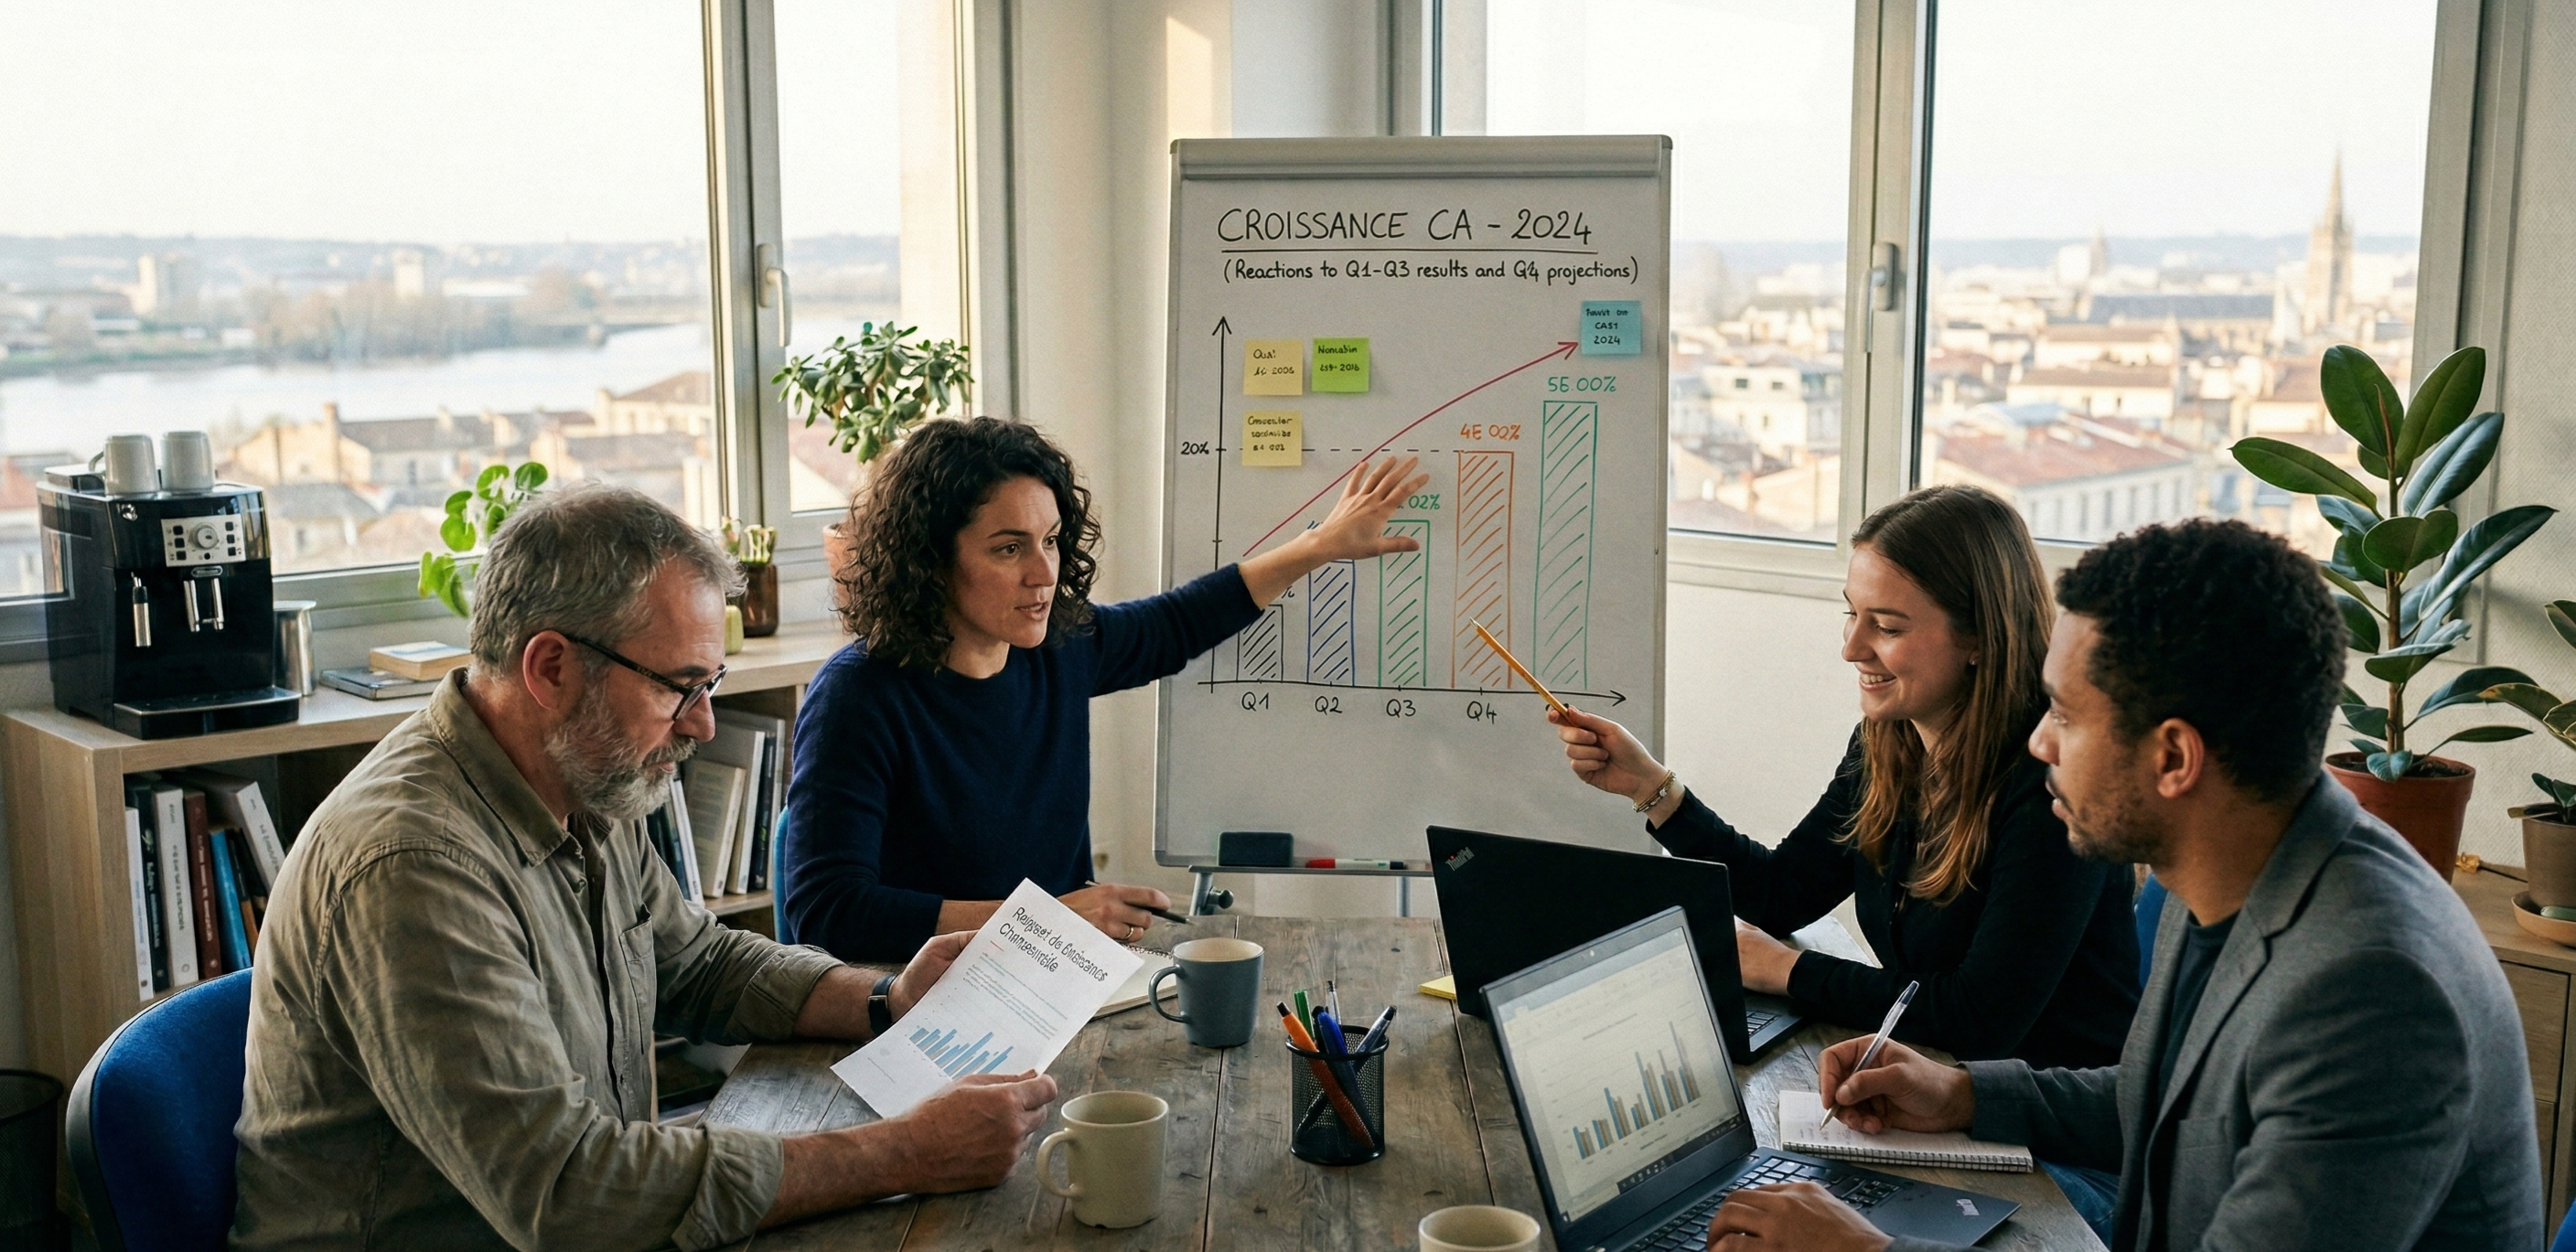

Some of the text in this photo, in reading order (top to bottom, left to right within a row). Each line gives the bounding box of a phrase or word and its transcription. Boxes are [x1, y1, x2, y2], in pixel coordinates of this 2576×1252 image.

[1218, 209, 1409, 242] CROISSANCE
[1428, 209, 1472, 241] CA
[1511, 209, 1593, 245] 2024
[1224, 258, 1314, 284] (Reactions
[1320, 260, 1338, 278] to
[1346, 259, 1411, 278] Q1-Q3
[1417, 259, 1469, 278] results
[1475, 260, 1506, 278] and
[1547, 256, 1638, 286] projections)
[1594, 336, 1620, 346] 2024
[1180, 441, 1209, 455] 20%
[1241, 691, 1497, 724] Q1 Q2 Q3 Q4
